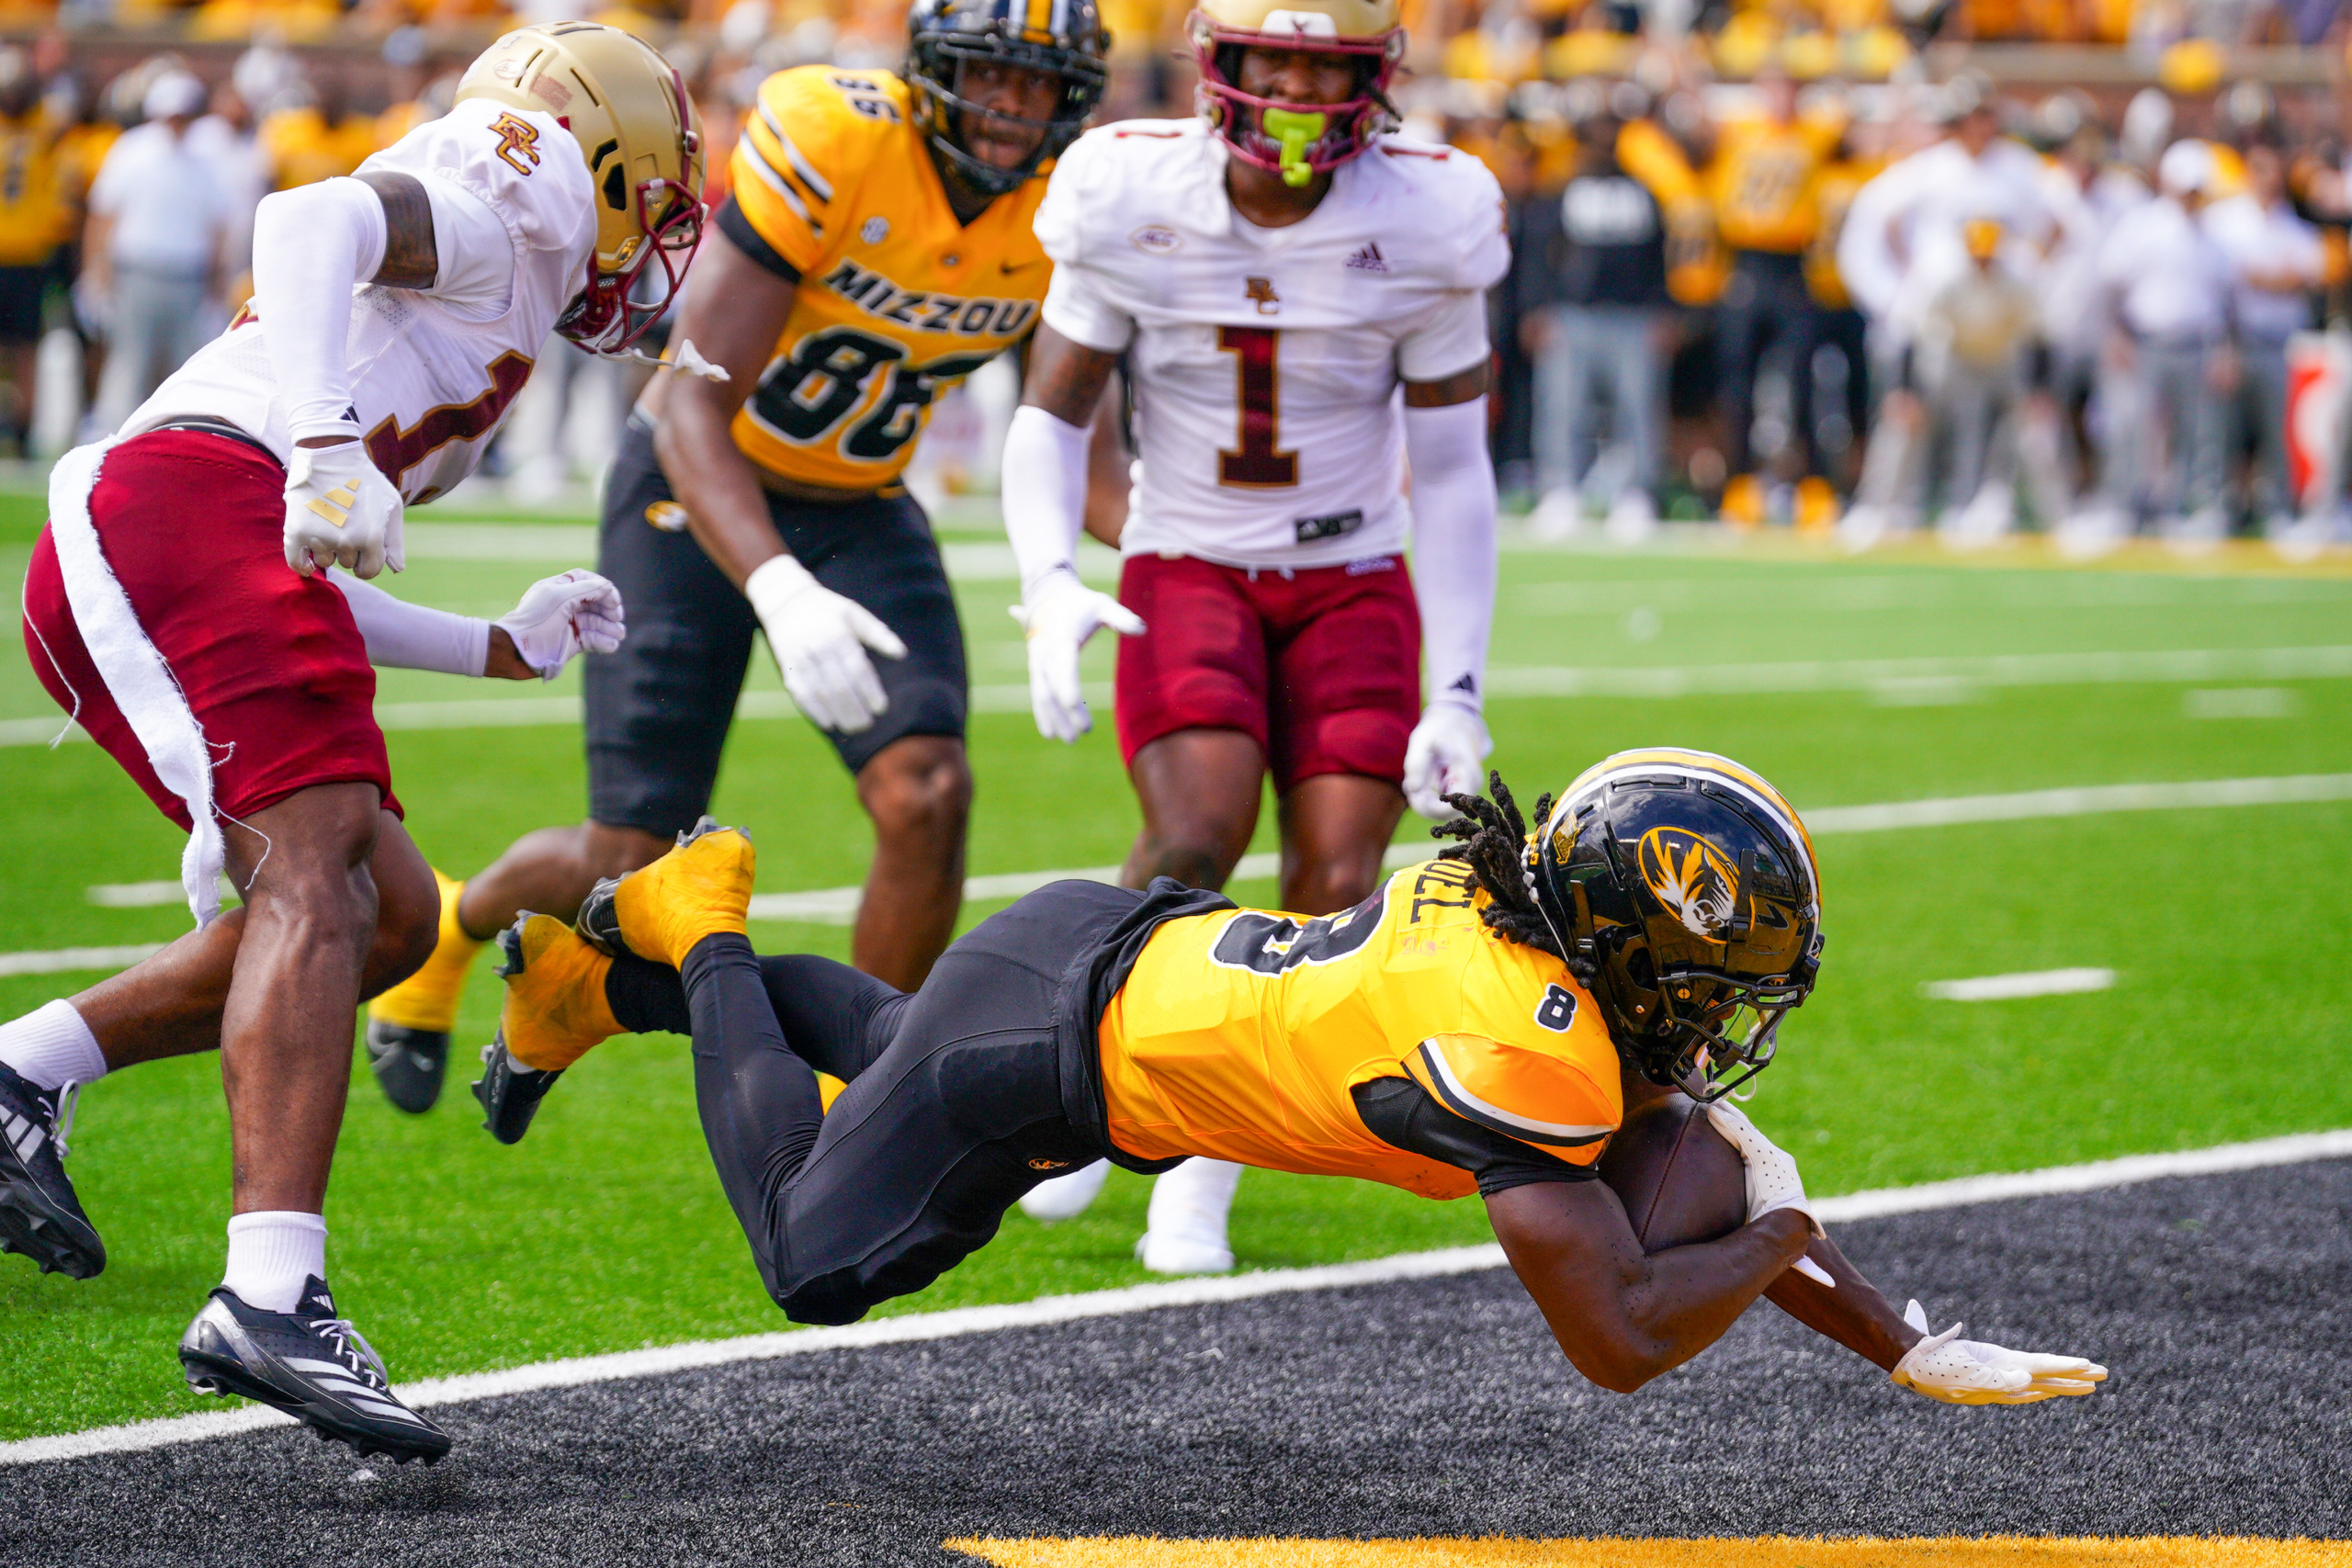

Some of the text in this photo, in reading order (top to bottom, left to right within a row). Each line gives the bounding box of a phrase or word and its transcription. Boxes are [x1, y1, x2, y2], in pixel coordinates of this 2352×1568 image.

[487, 111, 540, 176] BC
[820, 255, 1040, 338] MIZZOU
[745, 324, 1001, 463] 86
[1217, 325, 1299, 488] 1
[1207, 871, 1399, 979] 8
[1533, 982, 1578, 1033] 8
